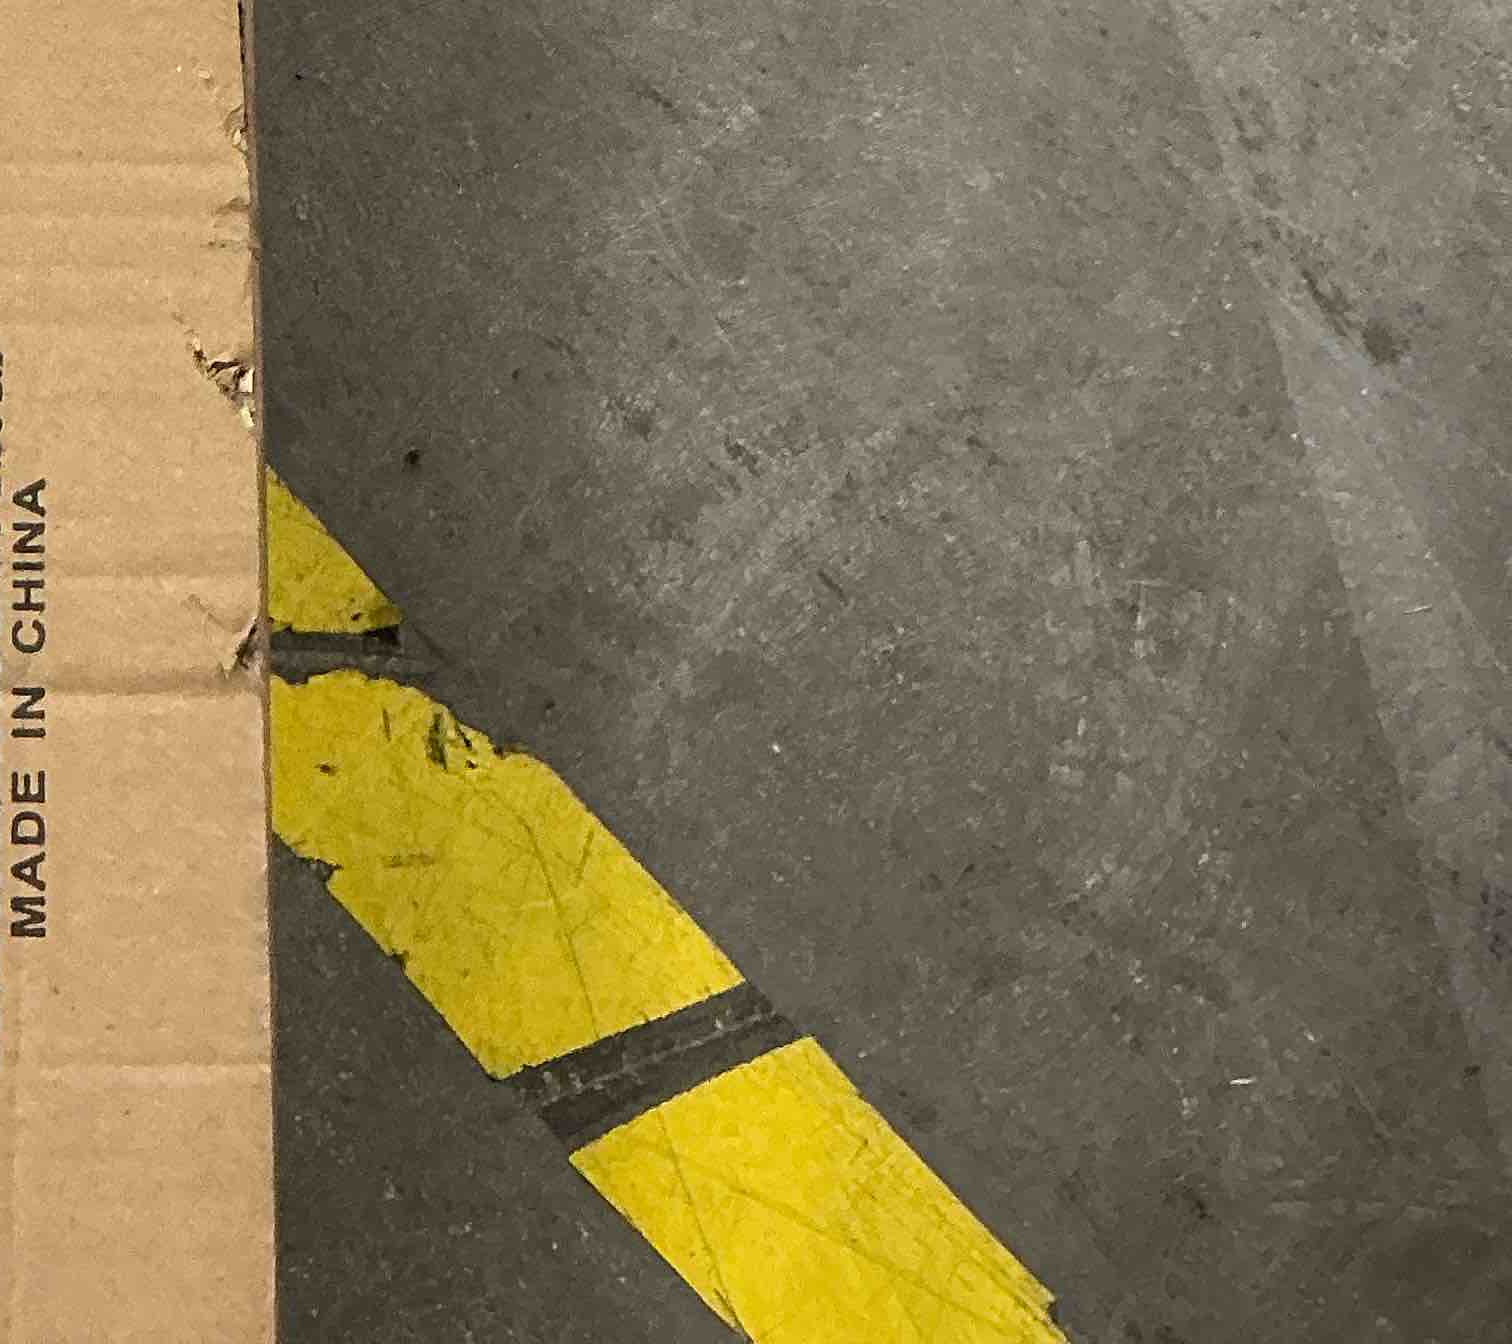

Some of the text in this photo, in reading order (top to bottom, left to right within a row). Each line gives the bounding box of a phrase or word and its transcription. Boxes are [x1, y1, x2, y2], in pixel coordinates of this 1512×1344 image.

[11, 478, 46, 938] MADE IN CHINA
